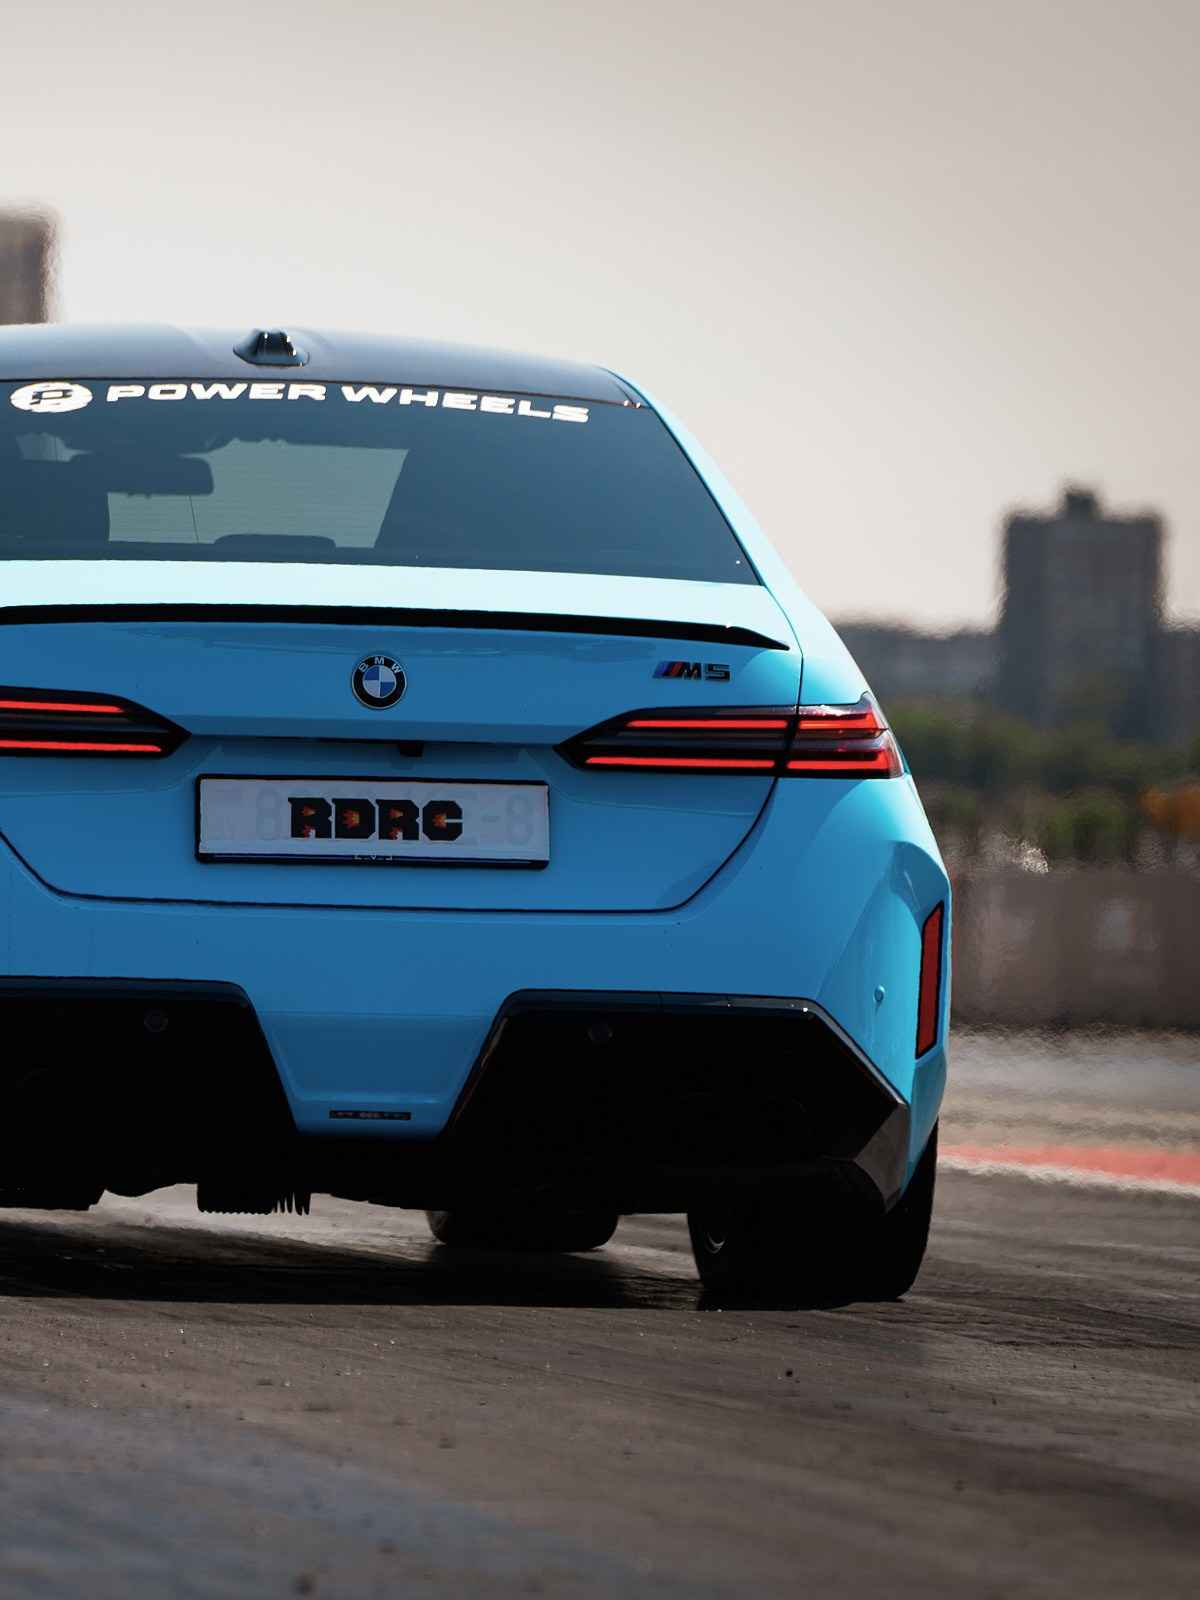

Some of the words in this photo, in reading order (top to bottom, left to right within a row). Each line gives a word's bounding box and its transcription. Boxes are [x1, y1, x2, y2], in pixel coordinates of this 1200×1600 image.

[106, 382, 326, 402] POWER
[341, 384, 589, 424] WHEELS
[357, 656, 402, 674] BMW
[674, 660, 731, 681] M5
[288, 797, 463, 842] RDRC
